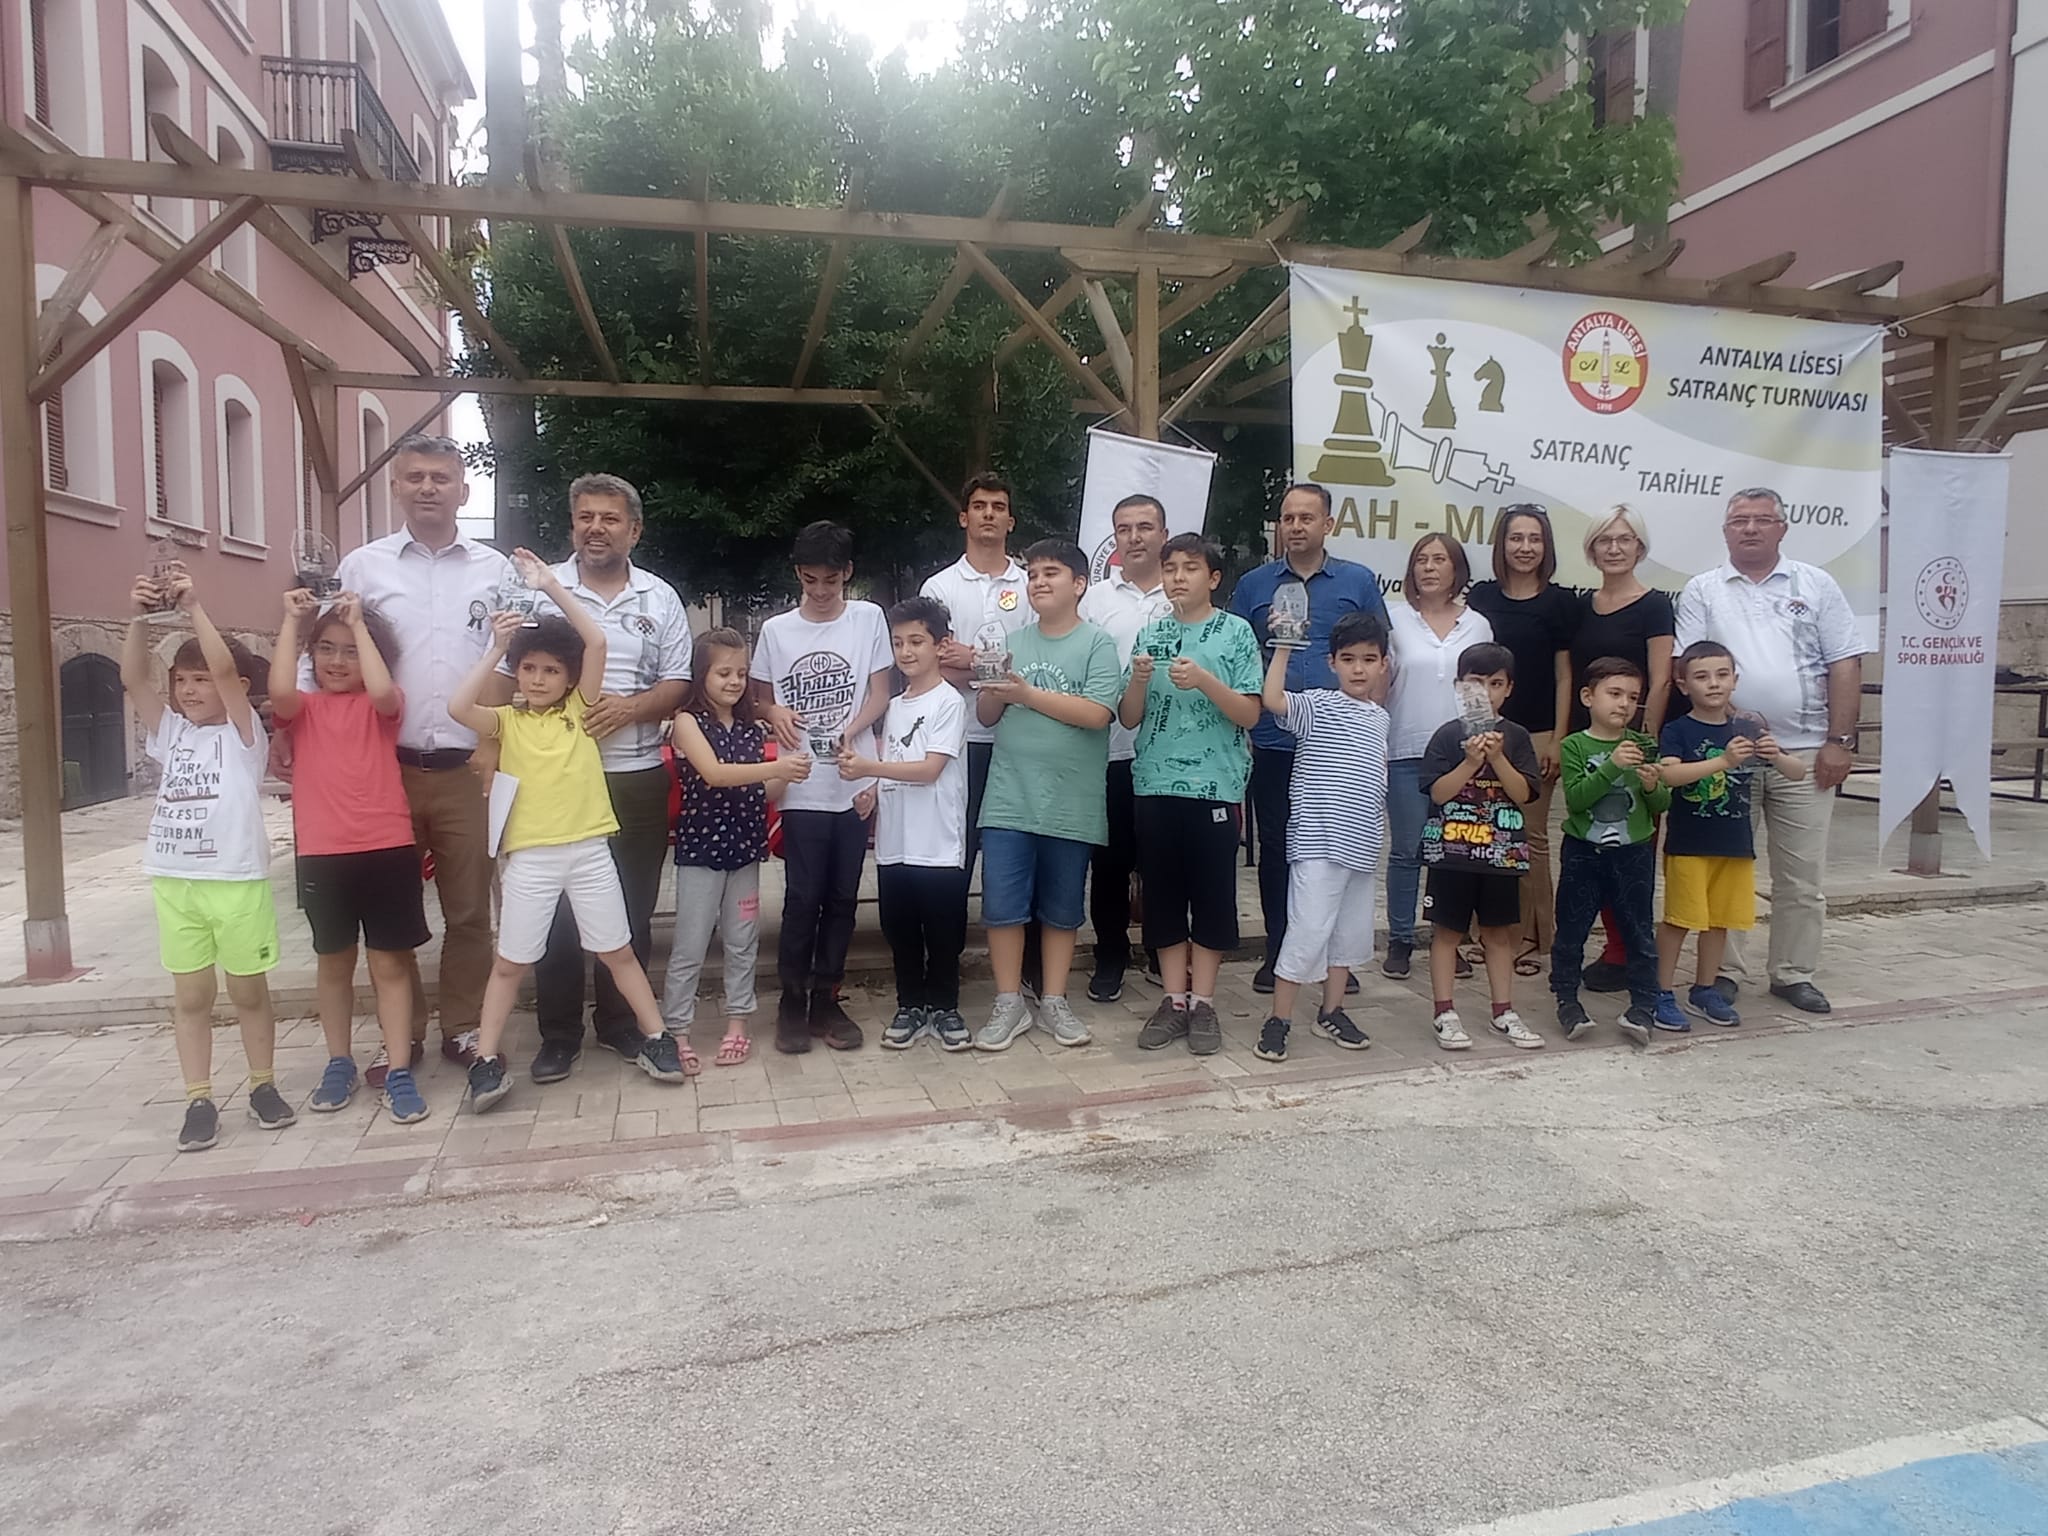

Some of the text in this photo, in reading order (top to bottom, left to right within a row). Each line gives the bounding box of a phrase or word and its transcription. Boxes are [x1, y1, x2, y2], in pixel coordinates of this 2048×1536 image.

[1567, 314, 1615, 353] ANTALYA
[1699, 346, 1843, 377] ANTALYA LİSESİ
[1667, 377, 1868, 413] SATRANÇ TURNUVASI
[1530, 438, 1632, 471] SATRANÇ
[1638, 468, 1724, 496] TARİHLE
[1332, 497, 1399, 540] AH
[1901, 635, 1920, 649] T.C.
[1967, 636, 1982, 648] VE
[1897, 650, 1985, 665] SPOR BAKANLIĞI
[155, 841, 178, 855] CITY
[163, 827, 204, 840] URBAN
